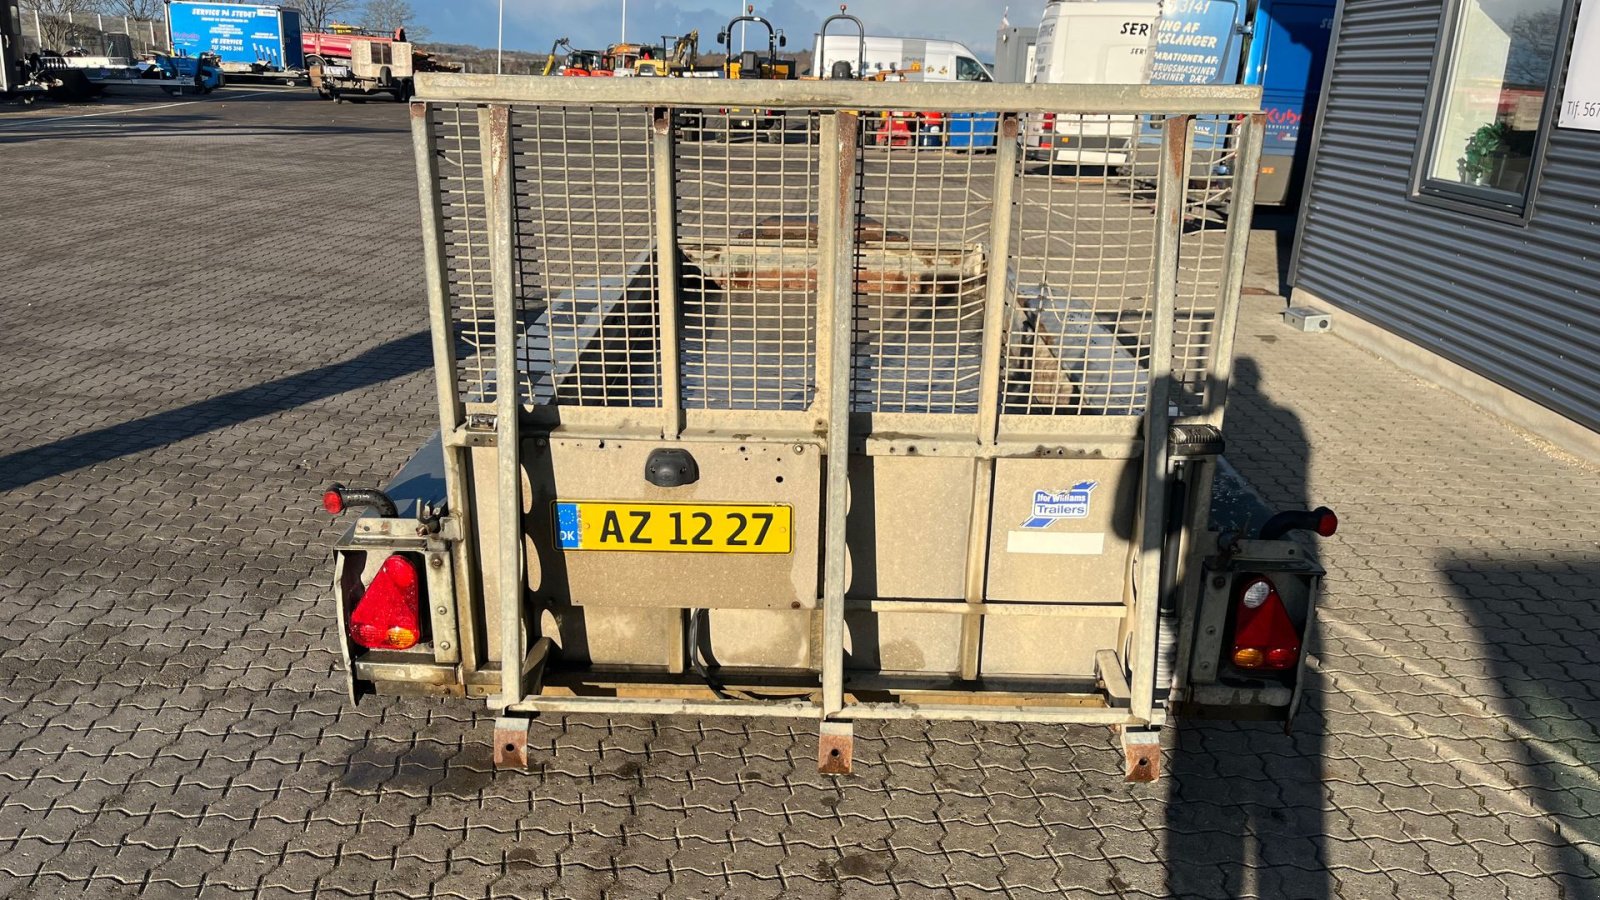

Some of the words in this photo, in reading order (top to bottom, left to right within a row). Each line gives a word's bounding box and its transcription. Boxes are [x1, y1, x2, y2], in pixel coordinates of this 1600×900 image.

[1120, 22, 1153, 36] SER
[1183, 22, 1200, 34] AF
[1567, 100, 1580, 119] Tlf.
[1052, 492, 1086, 502] Williams
[1037, 504, 1085, 515] Trailers
[600, 510, 653, 544] AZ
[669, 511, 714, 545] 12
[725, 512, 774, 546] 27
[560, 530, 576, 541] DK
